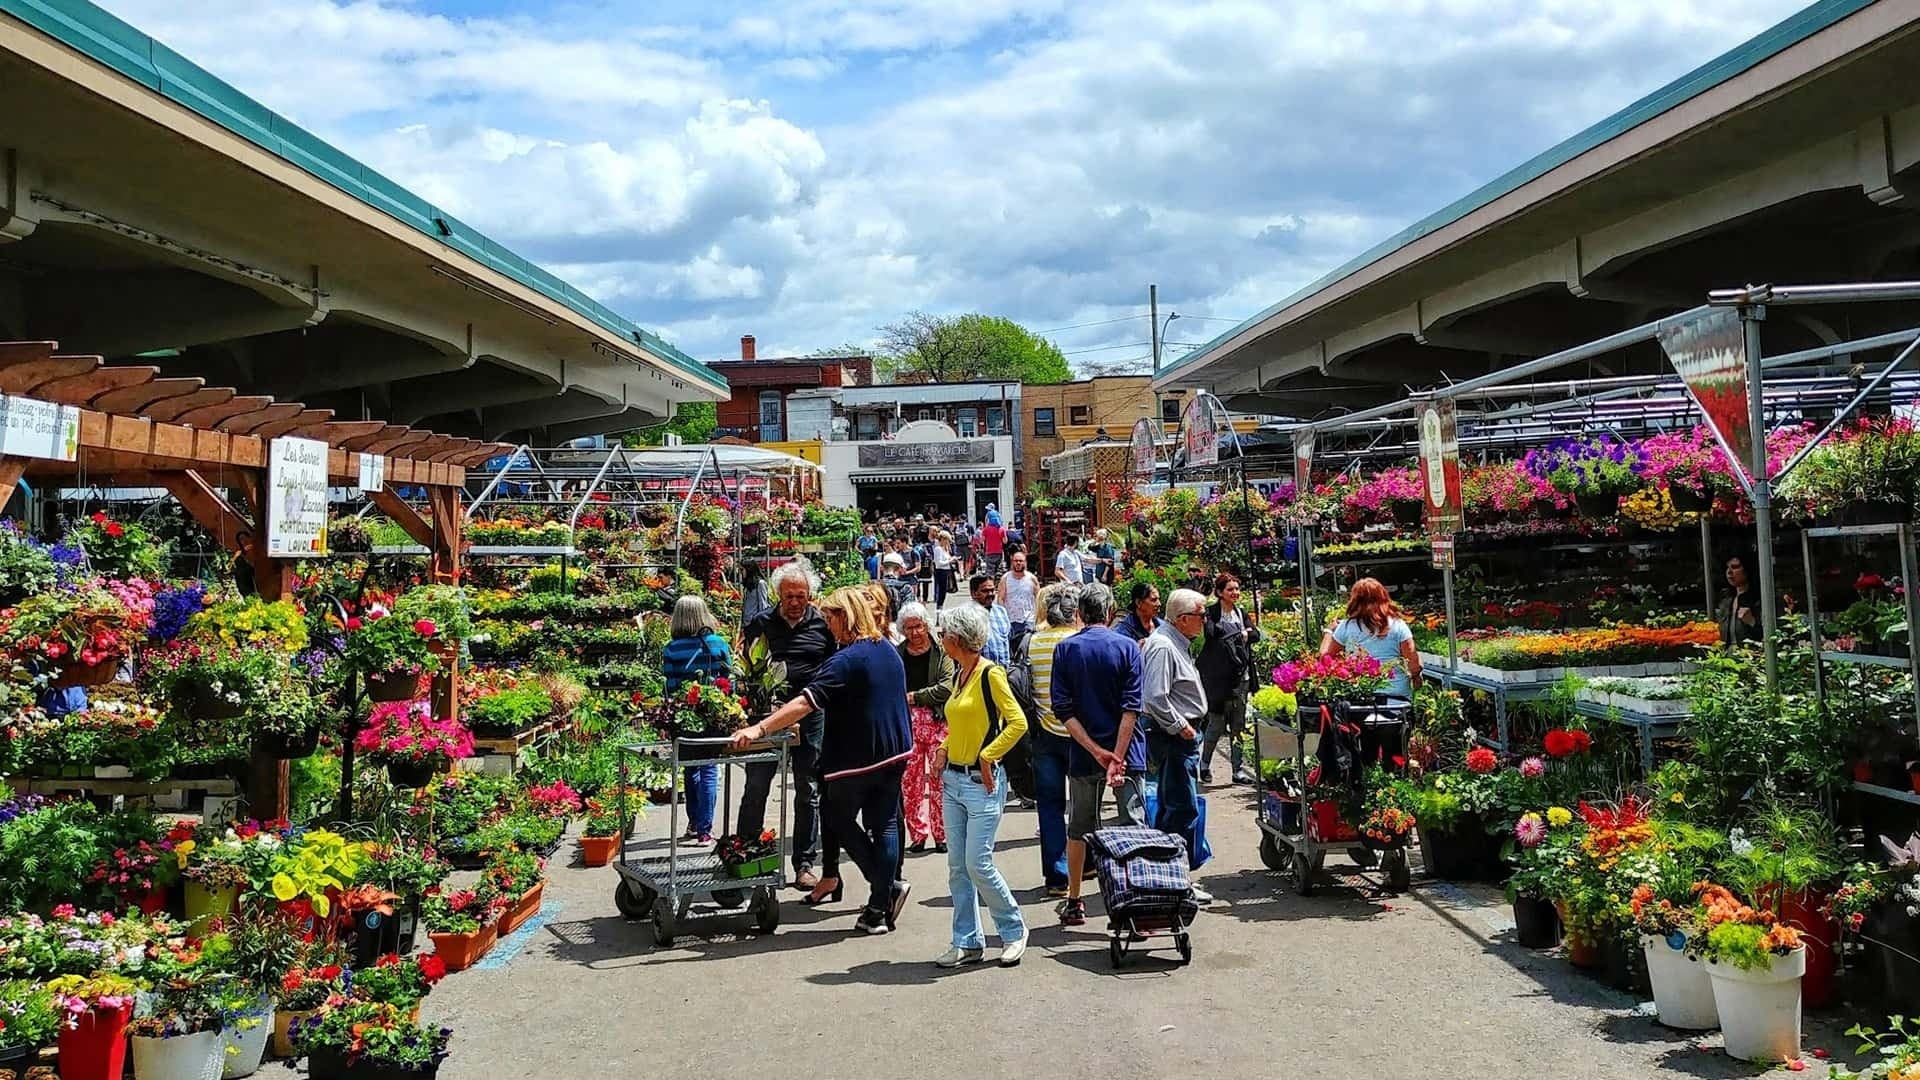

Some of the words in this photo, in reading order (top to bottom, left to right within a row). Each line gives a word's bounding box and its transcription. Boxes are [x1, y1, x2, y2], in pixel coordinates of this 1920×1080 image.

[283, 441, 298, 462] Les
[884, 447, 896, 457] LE
[287, 539, 312, 552] LAVAL
